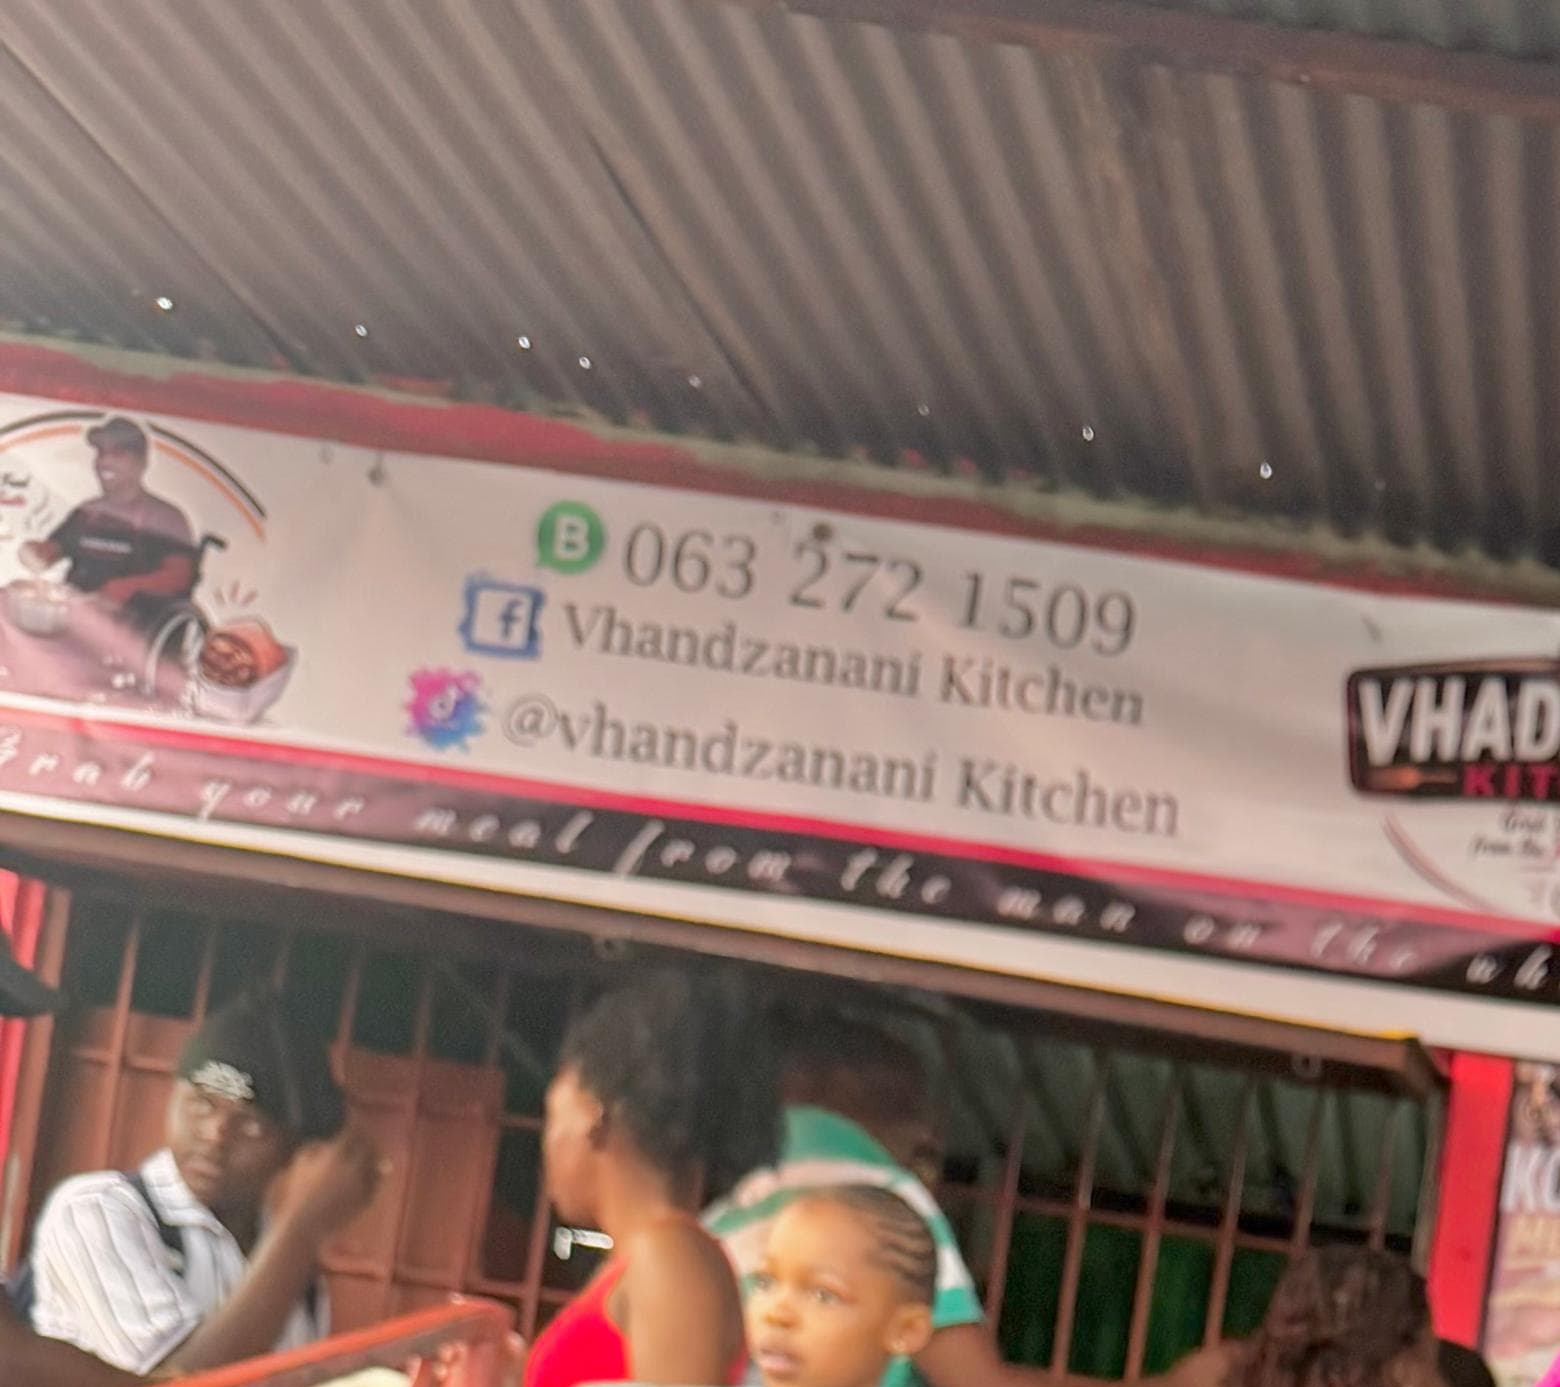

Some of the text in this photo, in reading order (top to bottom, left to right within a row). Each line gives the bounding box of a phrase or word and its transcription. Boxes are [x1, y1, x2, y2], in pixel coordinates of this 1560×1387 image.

[623, 520, 756, 600] 063
[789, 543, 923, 622] 272
[960, 568, 1136, 656] 1509
[563, 601, 922, 698] Vhandzanani
[940, 653, 1145, 727] Kitchen
[502, 693, 1180, 837] @vhandzanani Kitchen
[197, 781, 366, 822] your
[414, 806, 594, 855] meal
[612, 818, 792, 882] from
[841, 846, 952, 904] the
[997, 884, 1137, 934] man
[1182, 913, 1263, 950] on
[1311, 919, 1417, 968] the
